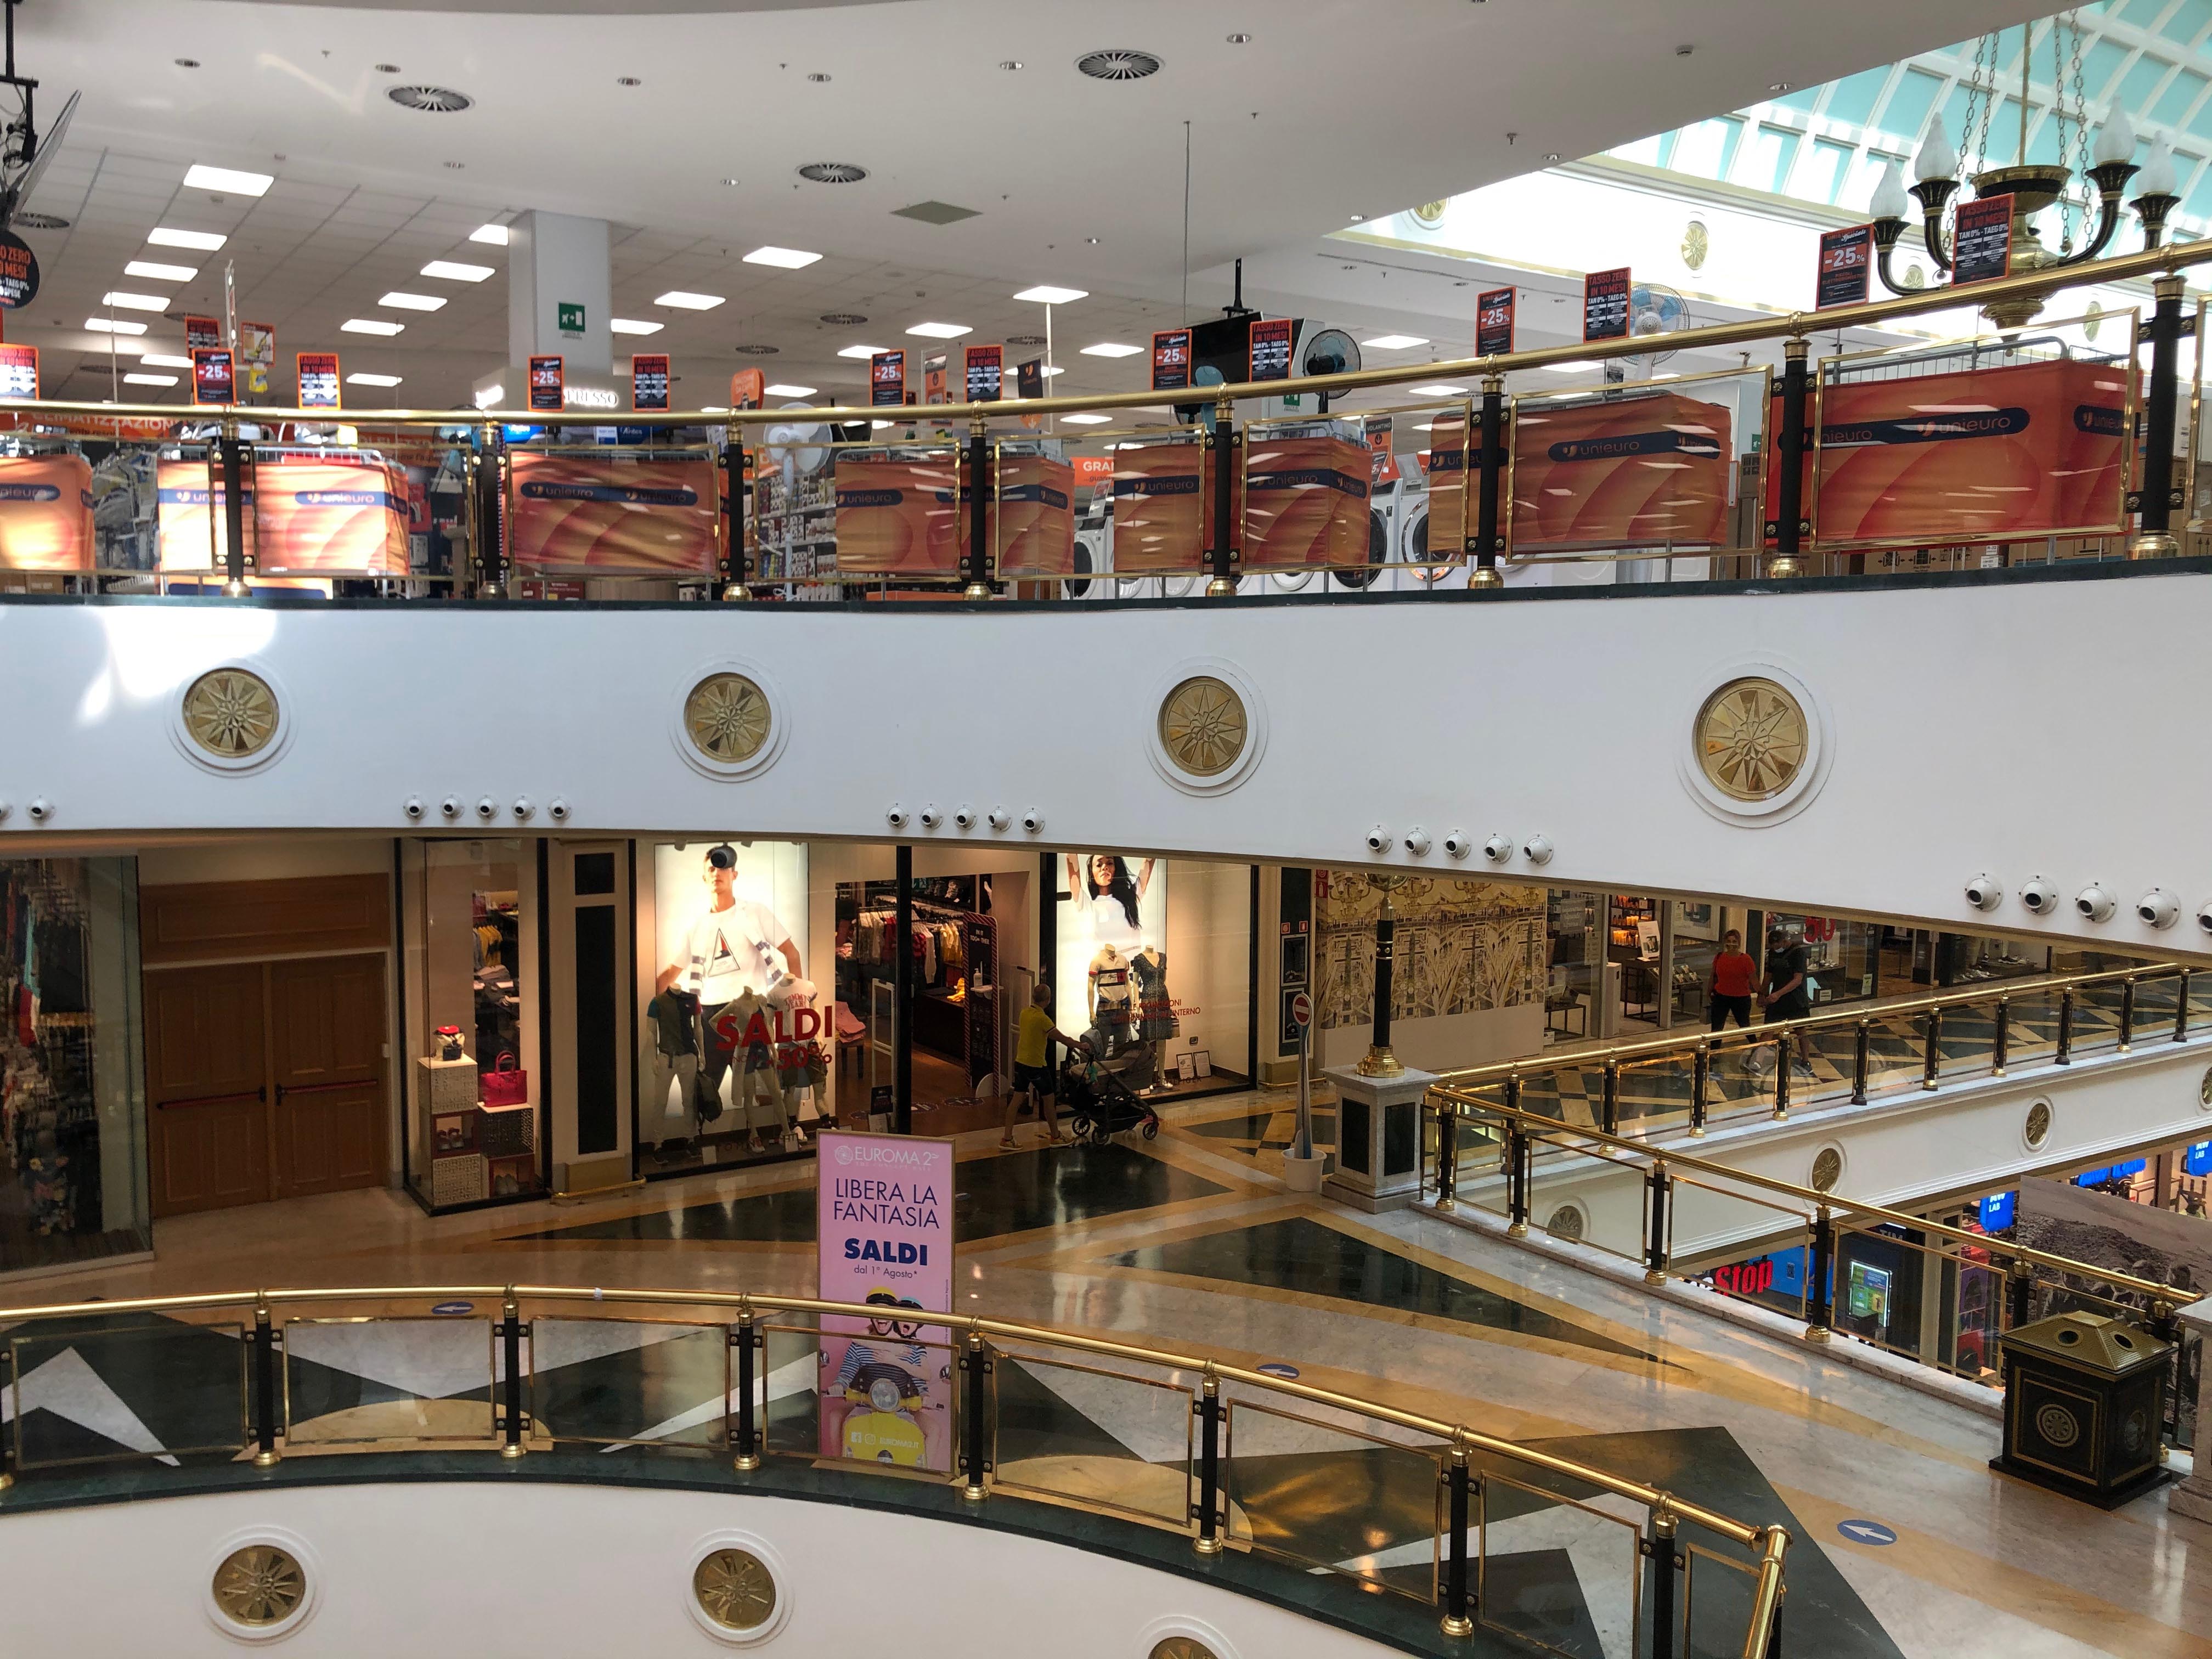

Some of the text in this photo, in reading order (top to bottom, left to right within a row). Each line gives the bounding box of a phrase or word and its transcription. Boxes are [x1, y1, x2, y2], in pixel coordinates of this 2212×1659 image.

[1959, 231, 1971, 240] TAN
[1984, 225, 1999, 235] TAEG
[8, 247, 31, 266] ZERO
[1825, 247, 1865, 267] -25%
[5, 263, 27, 280] MESI
[1589, 271, 1628, 286] TASSO ZERO
[1591, 283, 1626, 296] IN 10 MESI
[1481, 308, 1510, 325] -25%
[1264, 333, 1271, 341] 10
[1272, 331, 1287, 340] MESI
[1157, 348, 1186, 363] -25%
[198, 365, 230, 379] -25%
[533, 371, 560, 385] -25%
[875, 365, 902, 379] -25%
[1367, 422, 1391, 431] VOLANTINO
[1940, 416, 2011, 433] unieuro
[1581, 441, 1639, 455] unieuro
[1148, 480, 1194, 492] unieuro
[1267, 474, 1318, 486] unieuro
[322, 493, 375, 503] unieuro
[544, 486, 594, 498] unieuro
[847, 494, 893, 504] unieuro
[716, 1005, 833, 1051] SALDI
[2195, 1150, 2205, 1159] LAB
[836, 1178, 938, 1206] LIBERA LA
[1989, 1202, 2000, 1212] LAB
[834, 1200, 940, 1229] FANTASIA
[844, 1238, 928, 1266] SALDI
[854, 1265, 868, 1274] dal
[871, 1266, 881, 1275] 1°
